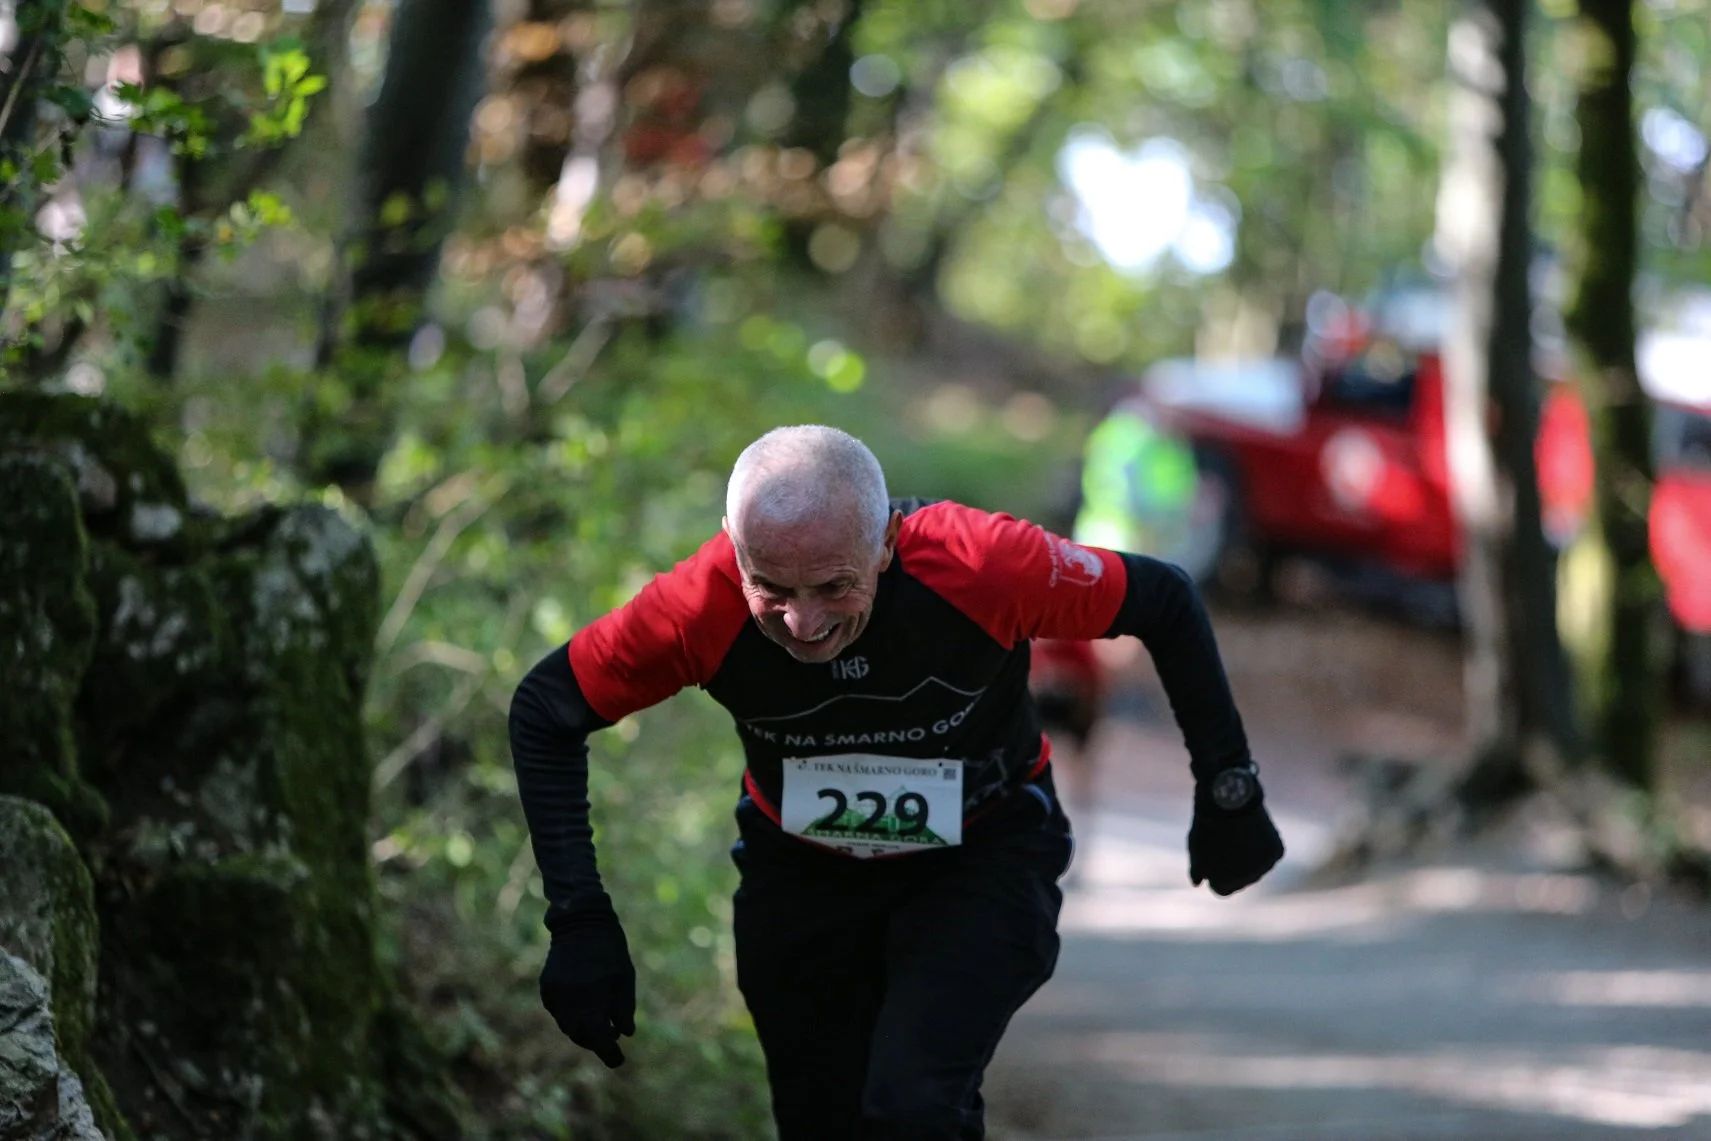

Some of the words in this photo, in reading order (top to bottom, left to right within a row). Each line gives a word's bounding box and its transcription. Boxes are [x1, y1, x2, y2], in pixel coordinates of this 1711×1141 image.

[784, 733, 817, 747] NA
[814, 763, 833, 772] TEK
[837, 763, 852, 774] NA
[904, 766, 938, 777] GORO
[816, 787, 929, 836] 229
